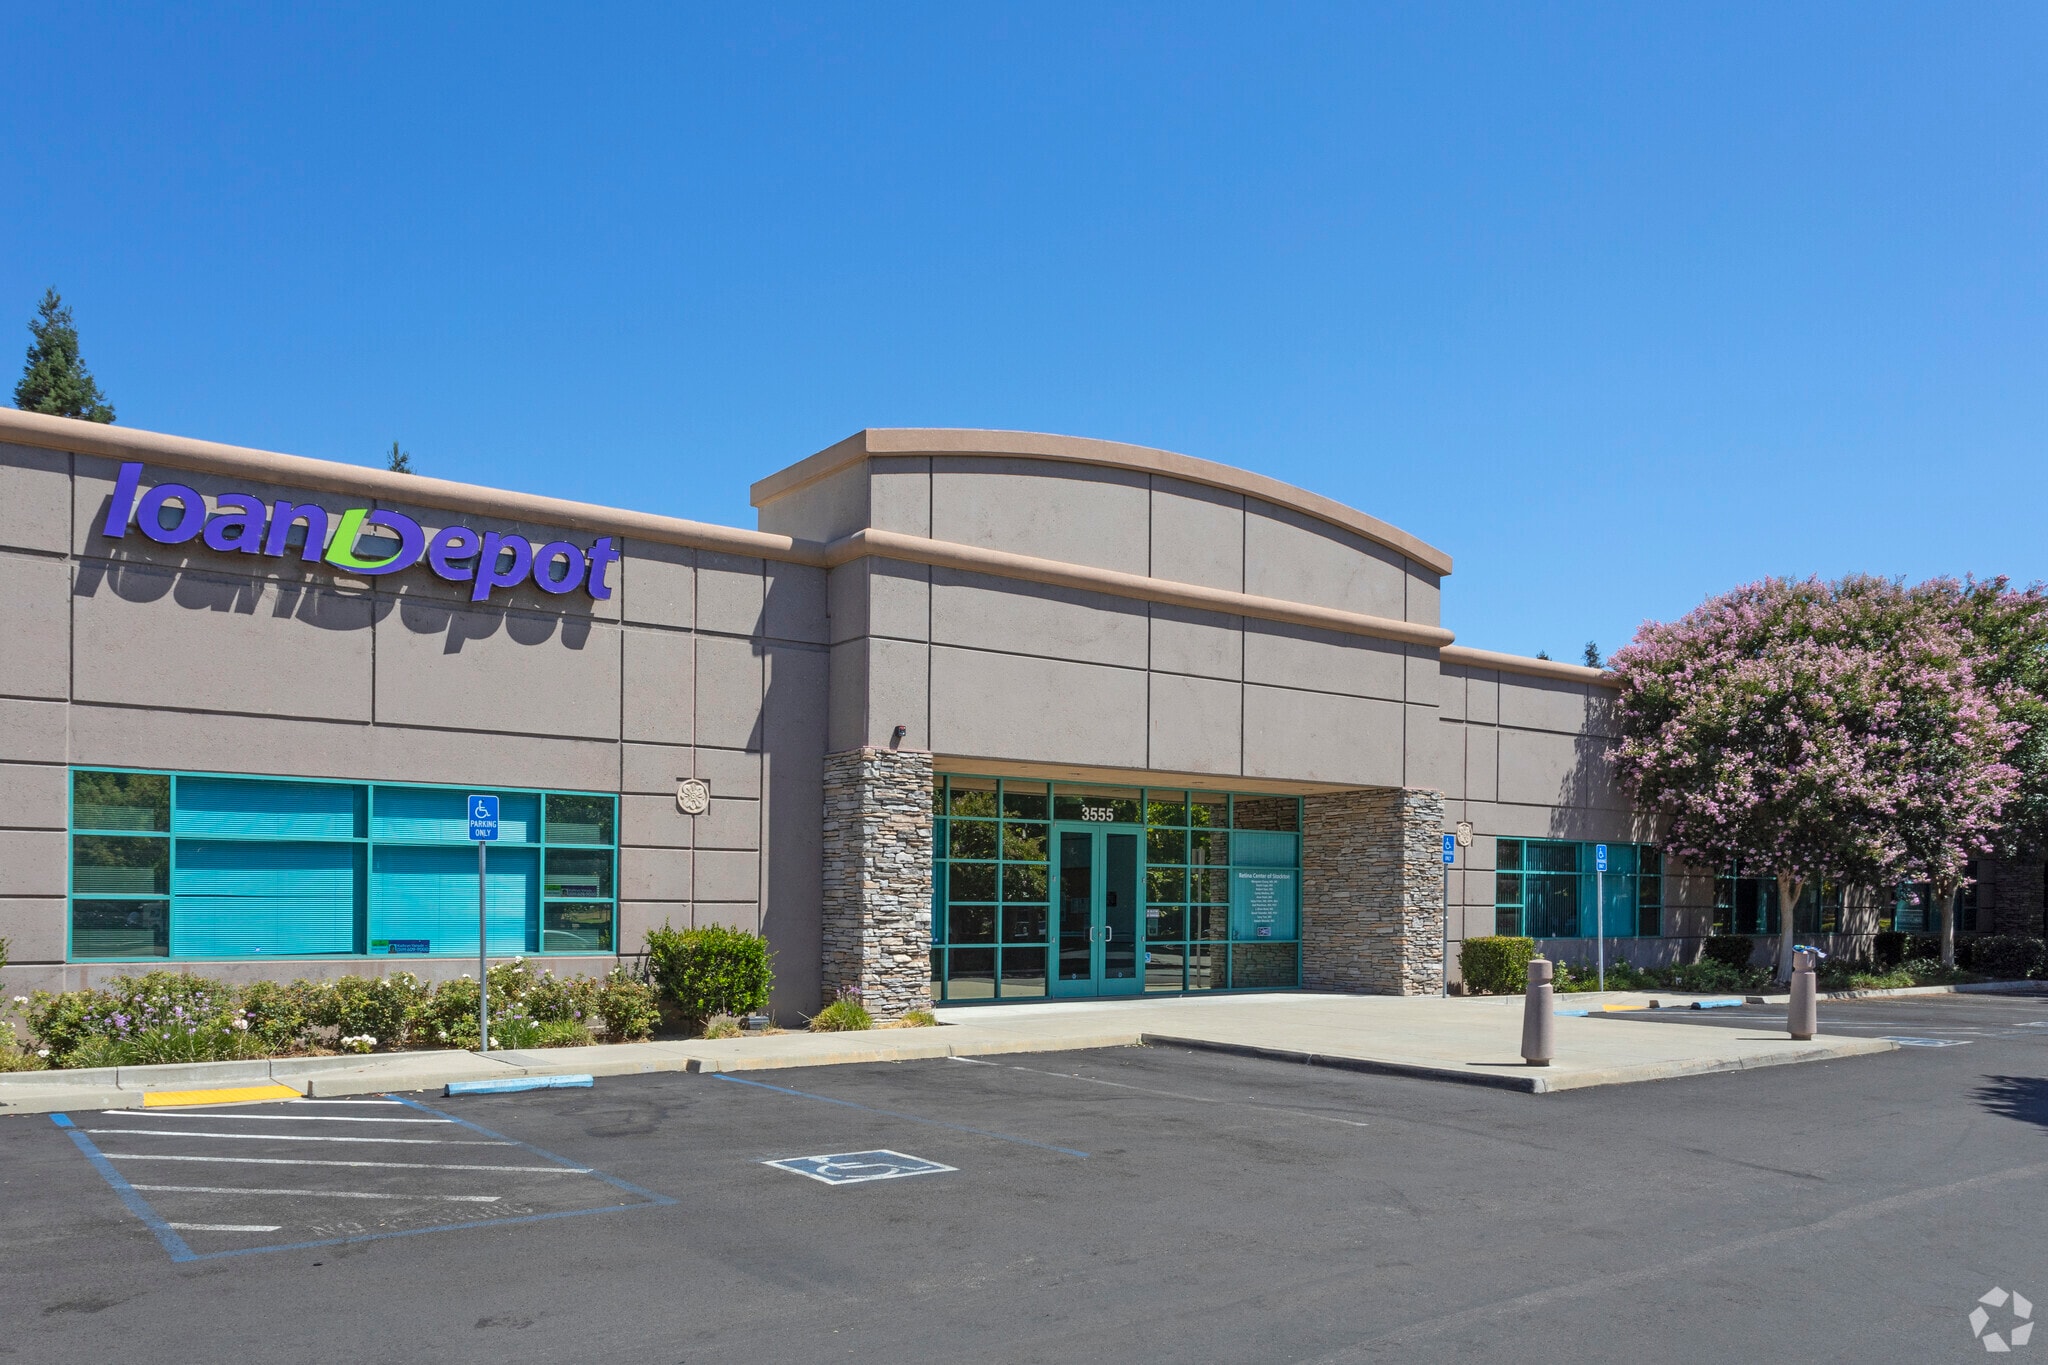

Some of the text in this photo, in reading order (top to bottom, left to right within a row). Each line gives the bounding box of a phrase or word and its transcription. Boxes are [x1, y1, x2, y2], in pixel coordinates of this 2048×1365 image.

[1081, 807, 1114, 822] 3555
[470, 820, 496, 828] PARKING
[475, 829, 491, 837] ONLY
